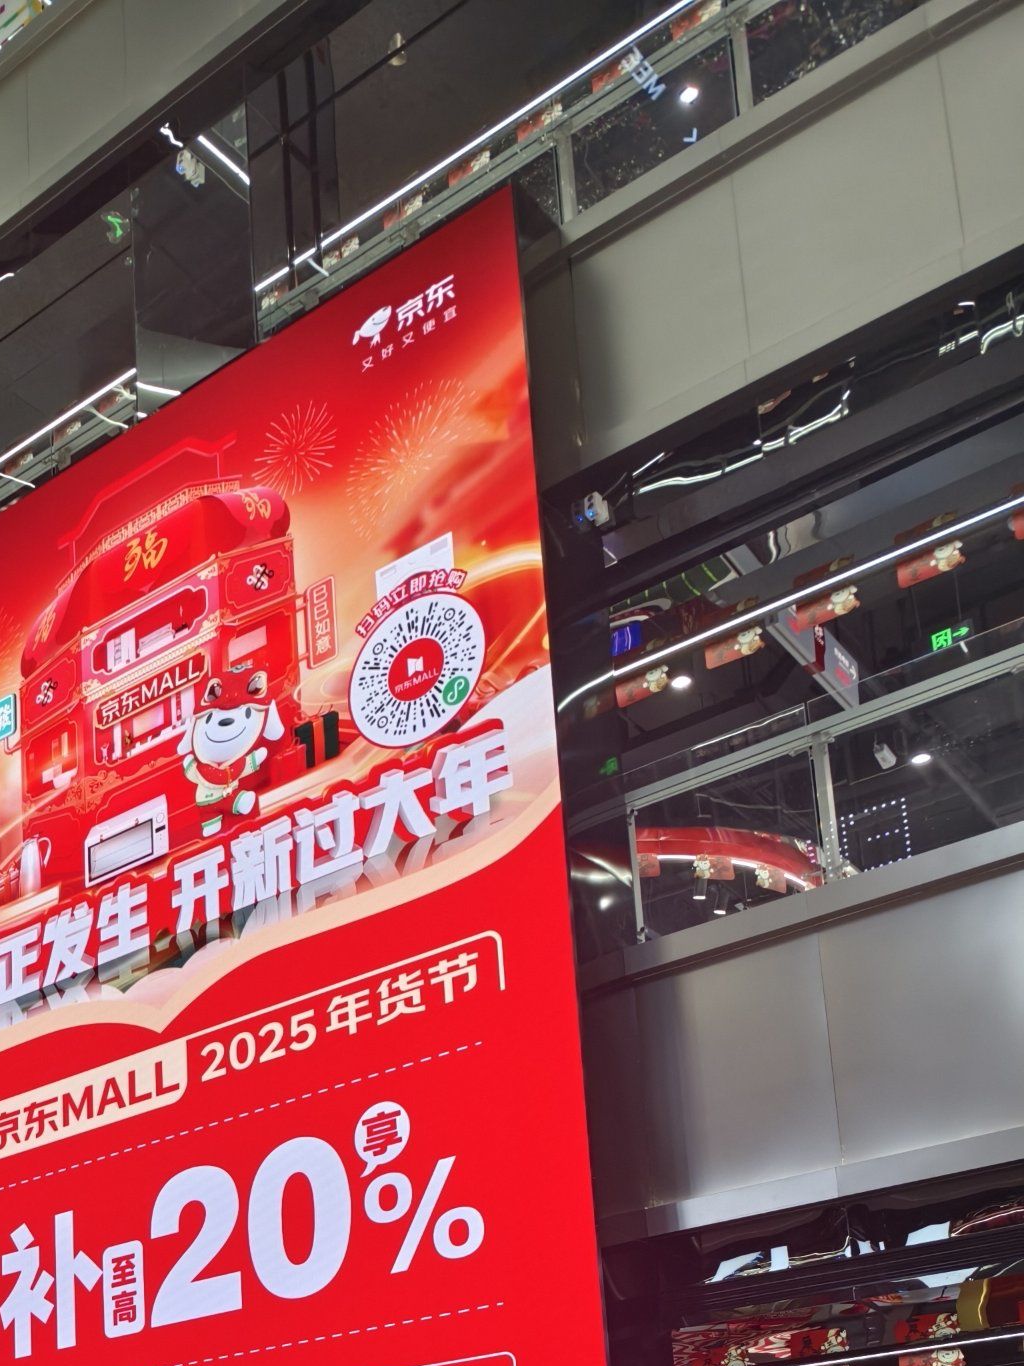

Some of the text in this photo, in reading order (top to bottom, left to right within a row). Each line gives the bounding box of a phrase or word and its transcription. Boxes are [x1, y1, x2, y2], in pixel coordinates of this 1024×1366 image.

[396, 274, 456, 332] 京东
[361, 306, 457, 372] 又好又便宜
[356, 568, 466, 638] 扫码立即抢购
[100, 657, 203, 727] 京东MALL
[394, 668, 440, 694] 京东MALL
[171, 728, 514, 931] 开新过大年
[110, 1253, 136, 1325] 至高
[150, 1136, 486, 1327] 20%
[362, 1107, 403, 1157] 享
